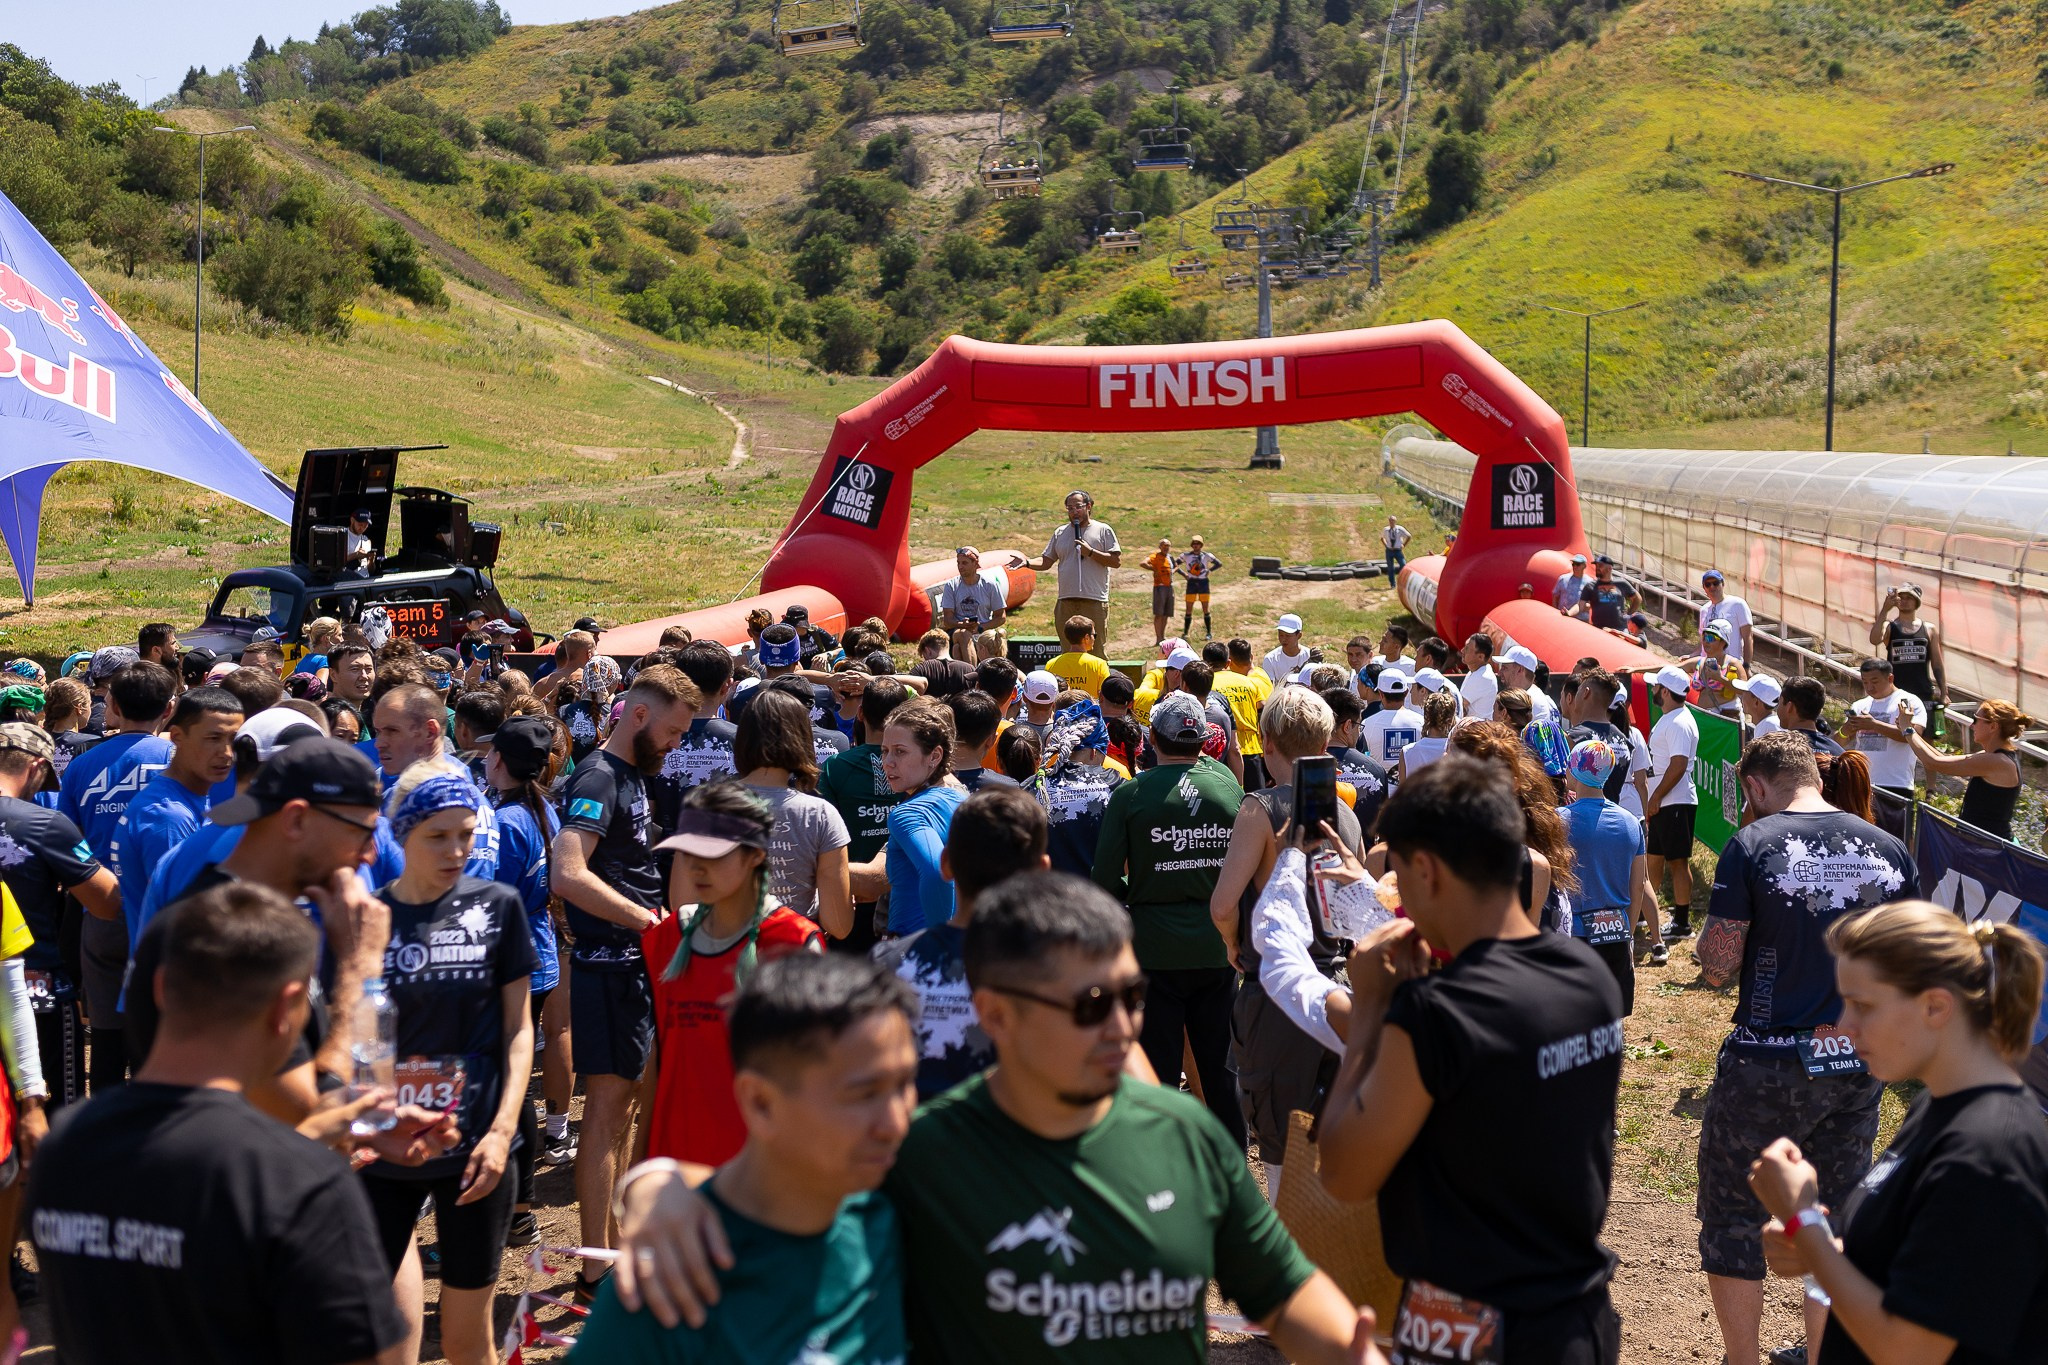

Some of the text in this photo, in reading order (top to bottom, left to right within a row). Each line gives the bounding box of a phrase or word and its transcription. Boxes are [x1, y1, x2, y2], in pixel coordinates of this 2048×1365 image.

[1100, 356, 1286, 408] FINISH
[836, 485, 875, 511] RACE
[1503, 493, 1544, 512] RACE
[831, 502, 870, 524] NATION
[1503, 512, 1544, 526] NATION
[384, 603, 444, 622] eam 5
[390, 622, 439, 639] 12:04
[1151, 823, 1234, 843] Schneider
[1822, 863, 1887, 872] ЭКСТРЕМАЛЬНАЯ
[1823, 871, 1862, 879] АТЛЕТИКА
[1591, 920, 1624, 935] 2049
[430, 930, 466, 945] 2023
[430, 944, 487, 963] NATION
[1810, 1035, 1857, 1058] 203
[1537, 1034, 1592, 1079] COMPEL
[1829, 1061, 1854, 1070] TEAM
[1855, 1059, 1861, 1067] 5
[32, 1208, 185, 1270] COMPEL SPORT
[985, 1267, 1204, 1317] Schneider
[1399, 1308, 1480, 1362] 2027
